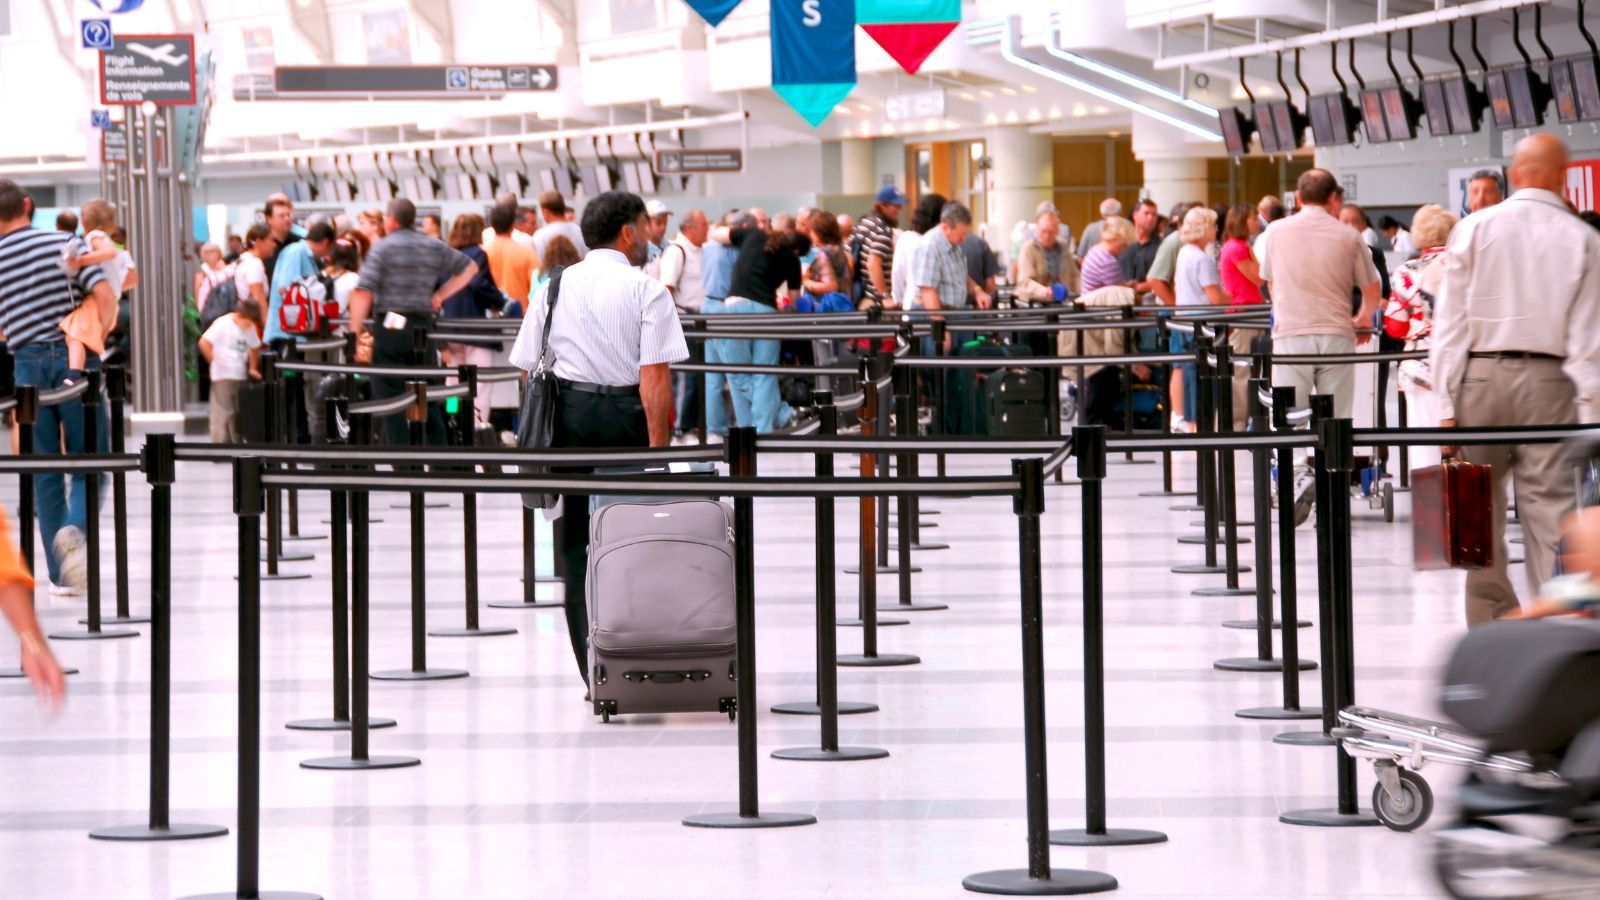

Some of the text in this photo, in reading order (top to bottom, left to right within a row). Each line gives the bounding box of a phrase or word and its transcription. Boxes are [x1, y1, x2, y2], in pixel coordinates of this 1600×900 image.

[802, 0, 822, 27] S
[105, 55, 135, 66] Flight
[105, 66, 164, 76] Information
[471, 67, 503, 78] Gates
[105, 80, 190, 92] Renseignements
[471, 79, 506, 89] Portes
[106, 91, 120, 101] de
